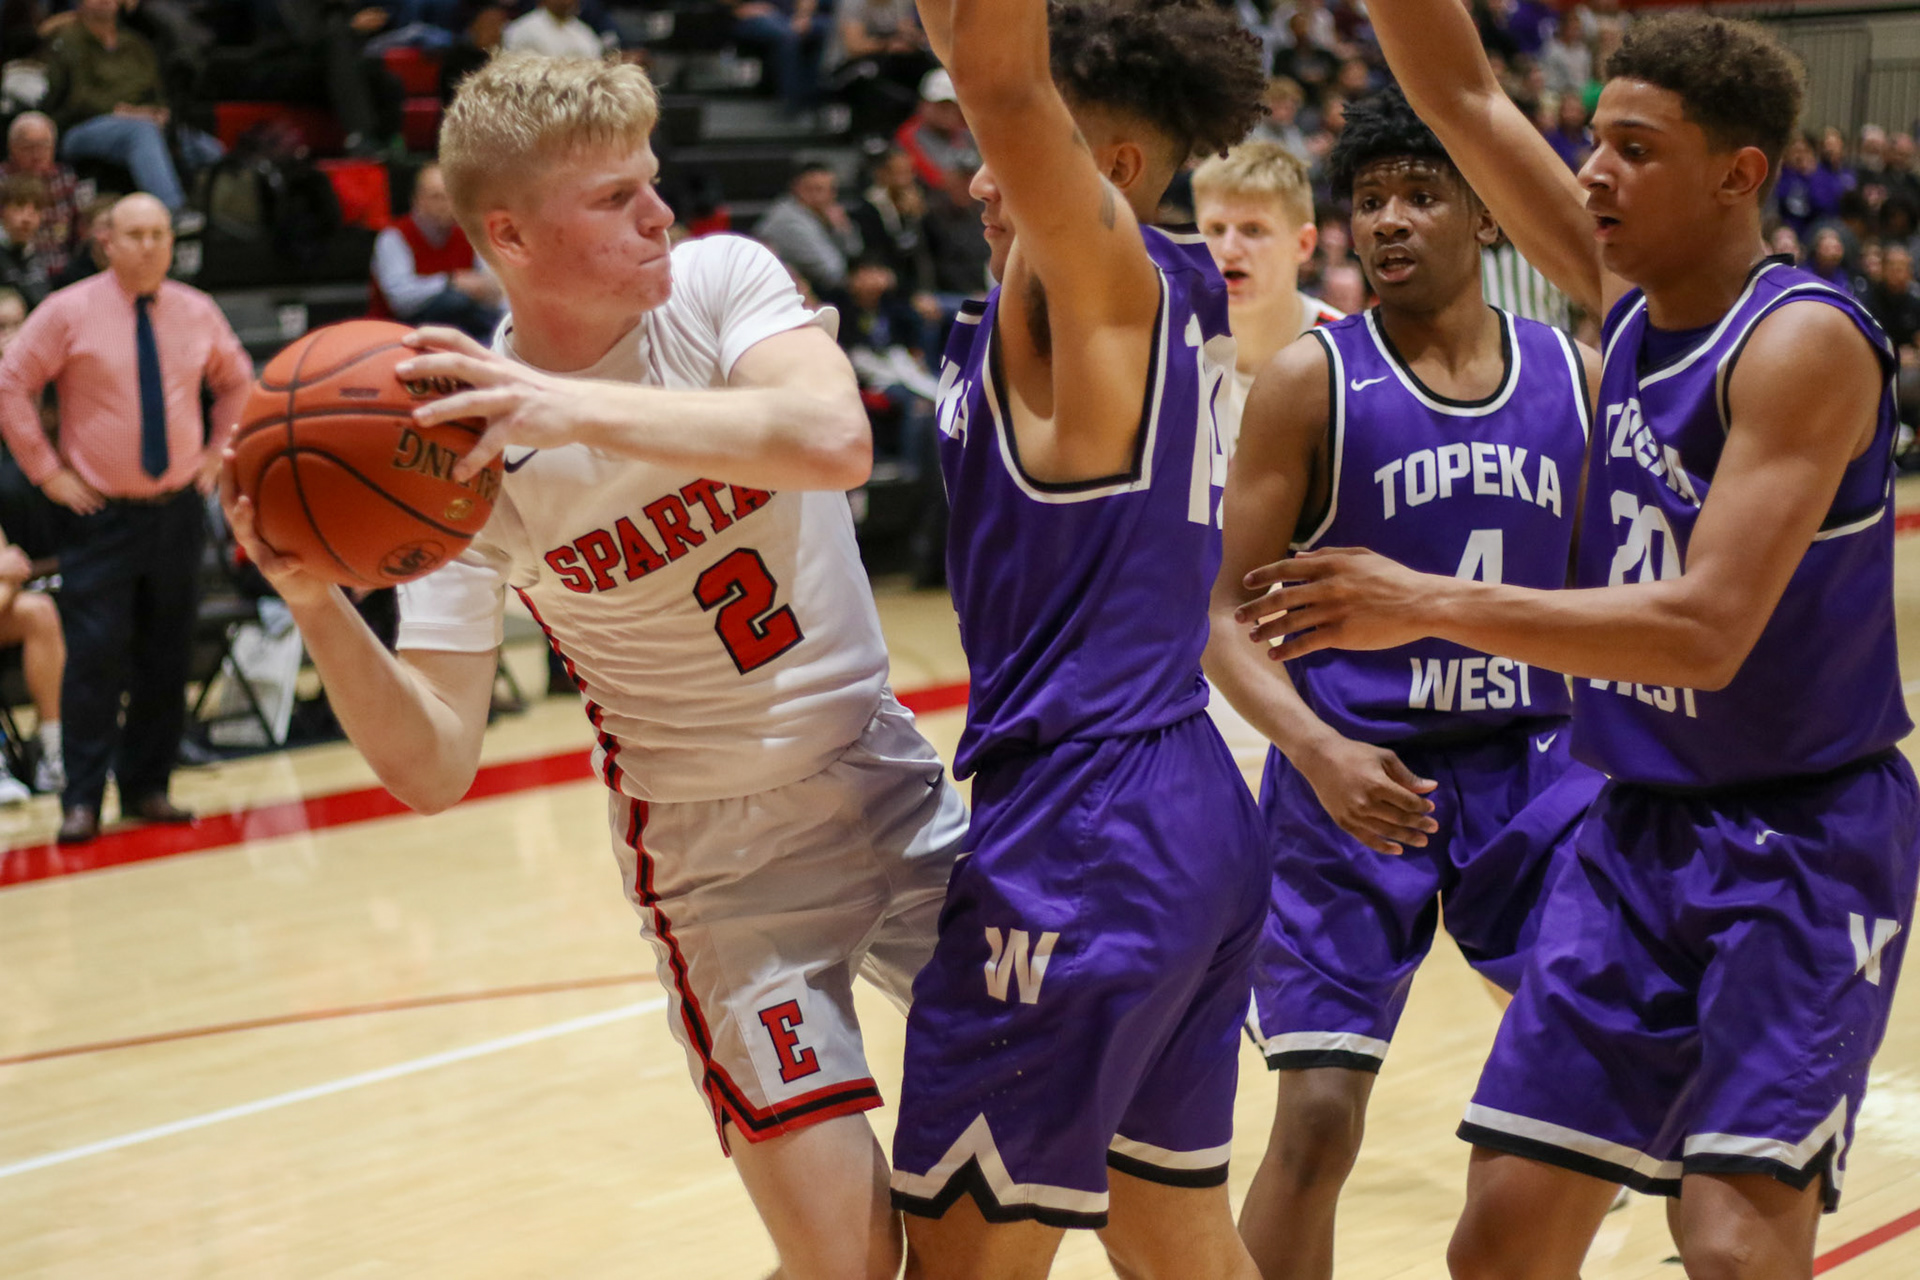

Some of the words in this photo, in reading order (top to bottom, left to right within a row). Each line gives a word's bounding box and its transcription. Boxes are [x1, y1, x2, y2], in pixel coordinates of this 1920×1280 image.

[1374, 441, 1562, 520] TOPEKA
[544, 477, 777, 594] SPARTA
[1610, 489, 1682, 587] 20
[693, 547, 805, 676] 2
[1408, 656, 1532, 712] WEST
[984, 926, 1060, 1005] W
[758, 998, 821, 1084] E
